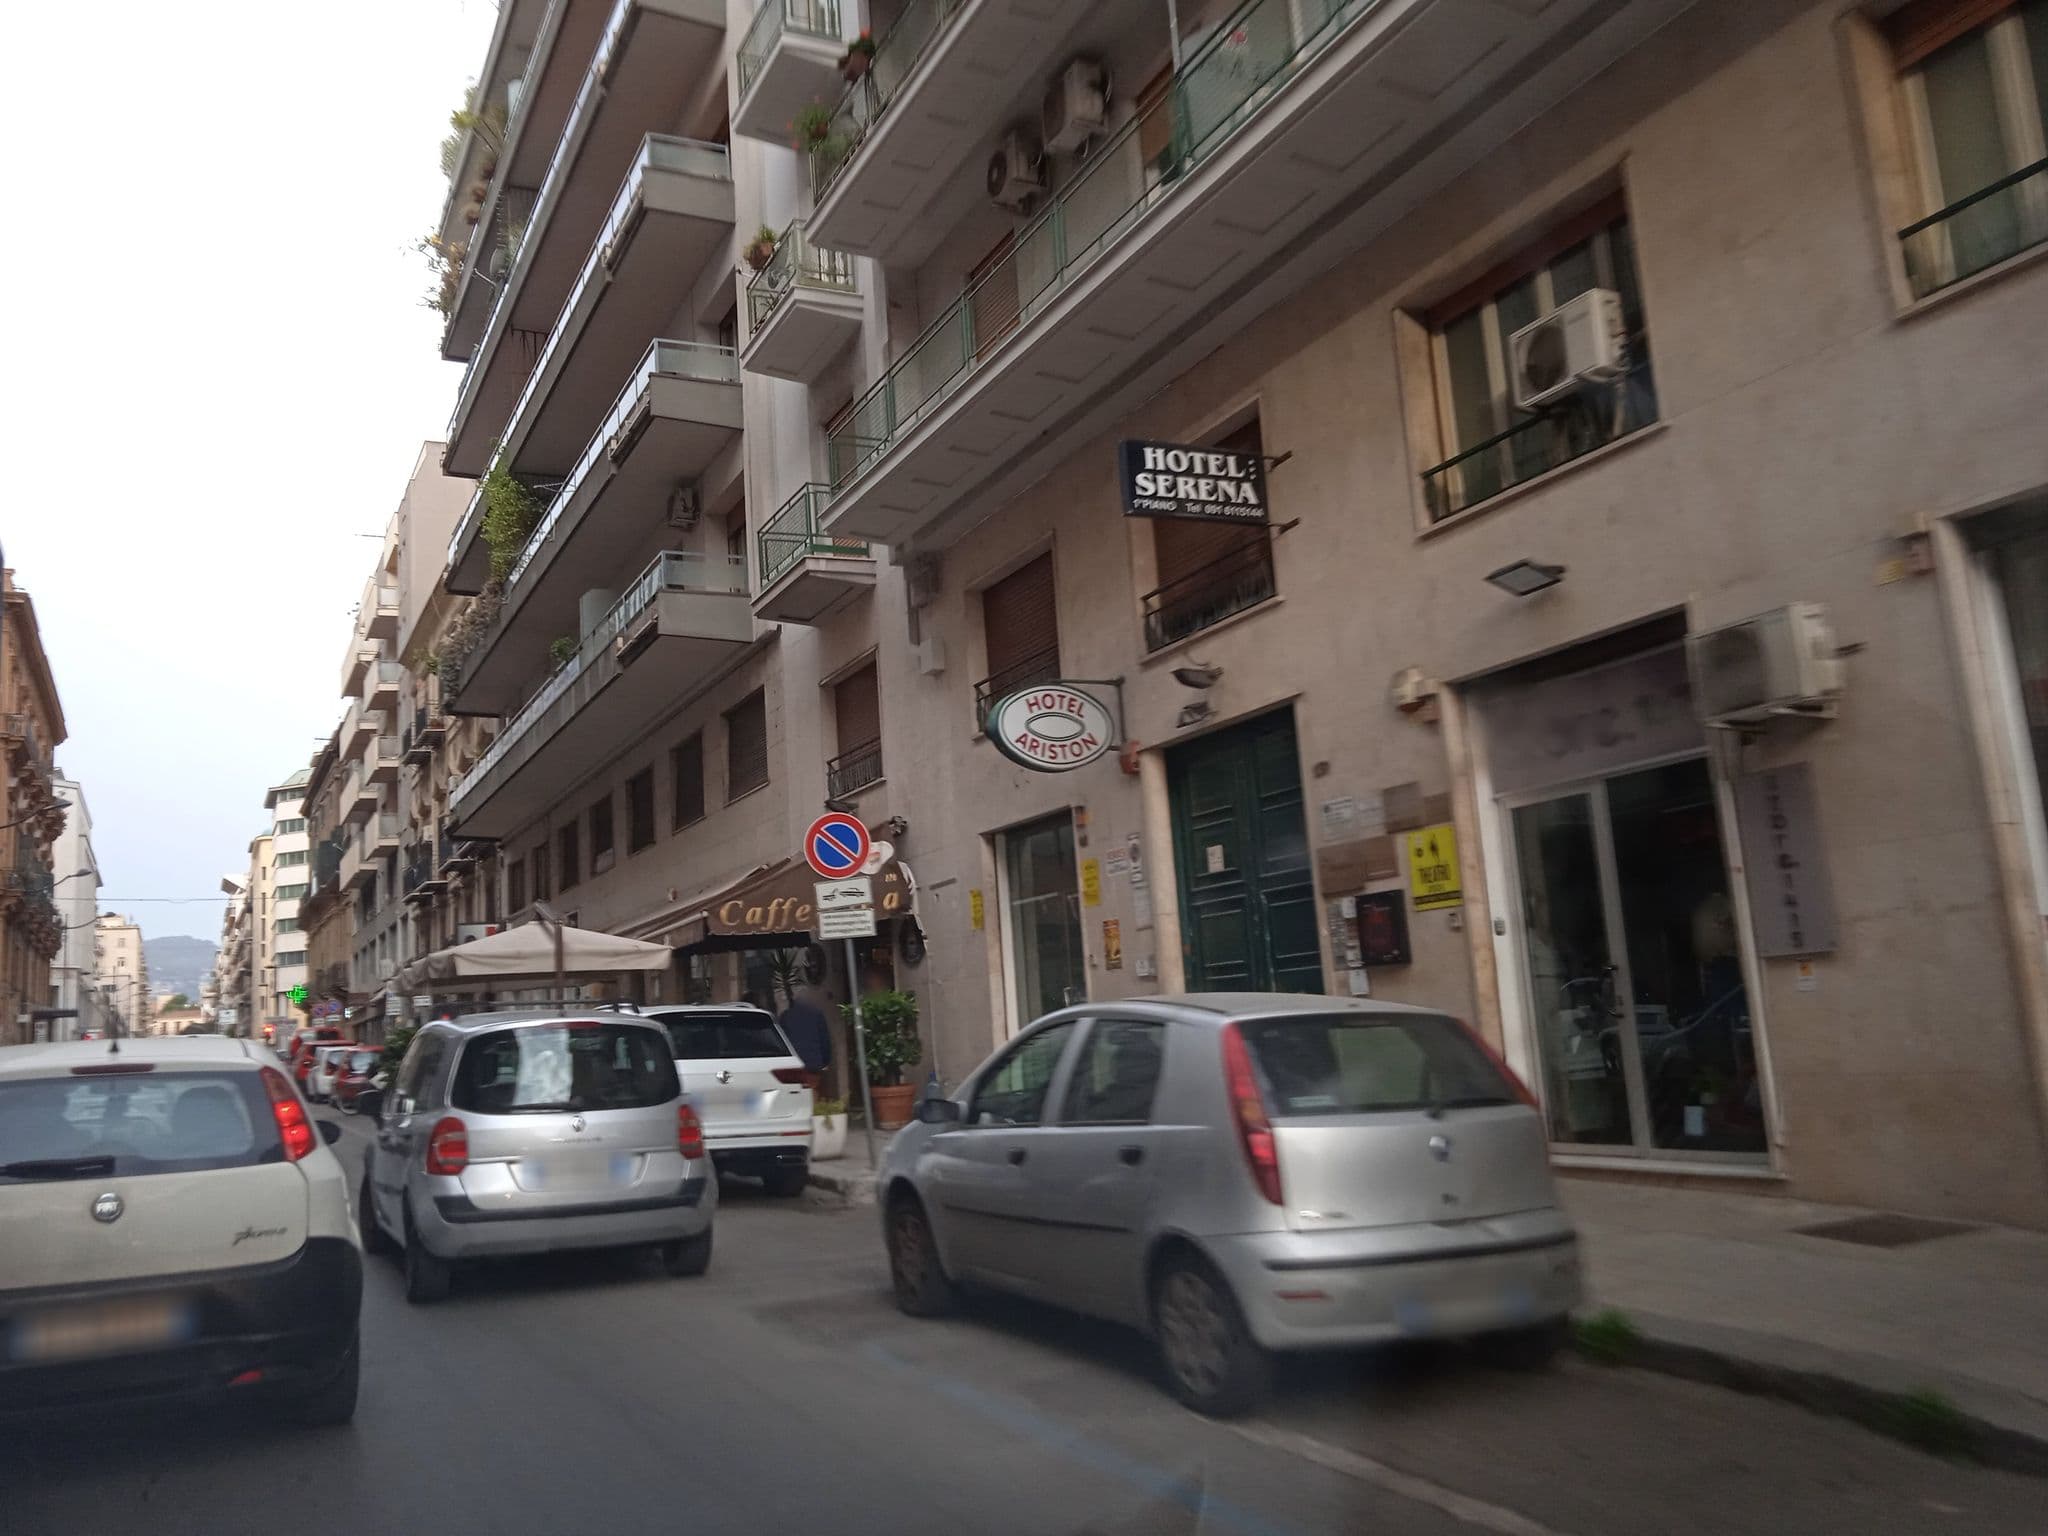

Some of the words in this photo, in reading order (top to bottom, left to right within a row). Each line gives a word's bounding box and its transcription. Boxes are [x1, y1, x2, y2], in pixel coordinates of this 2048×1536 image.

[1143, 447, 1247, 478] HOTEL
[1135, 472, 1260, 505] SERENA
[1025, 693, 1085, 719] HOTEL
[1015, 732, 1098, 761] ARISTON
